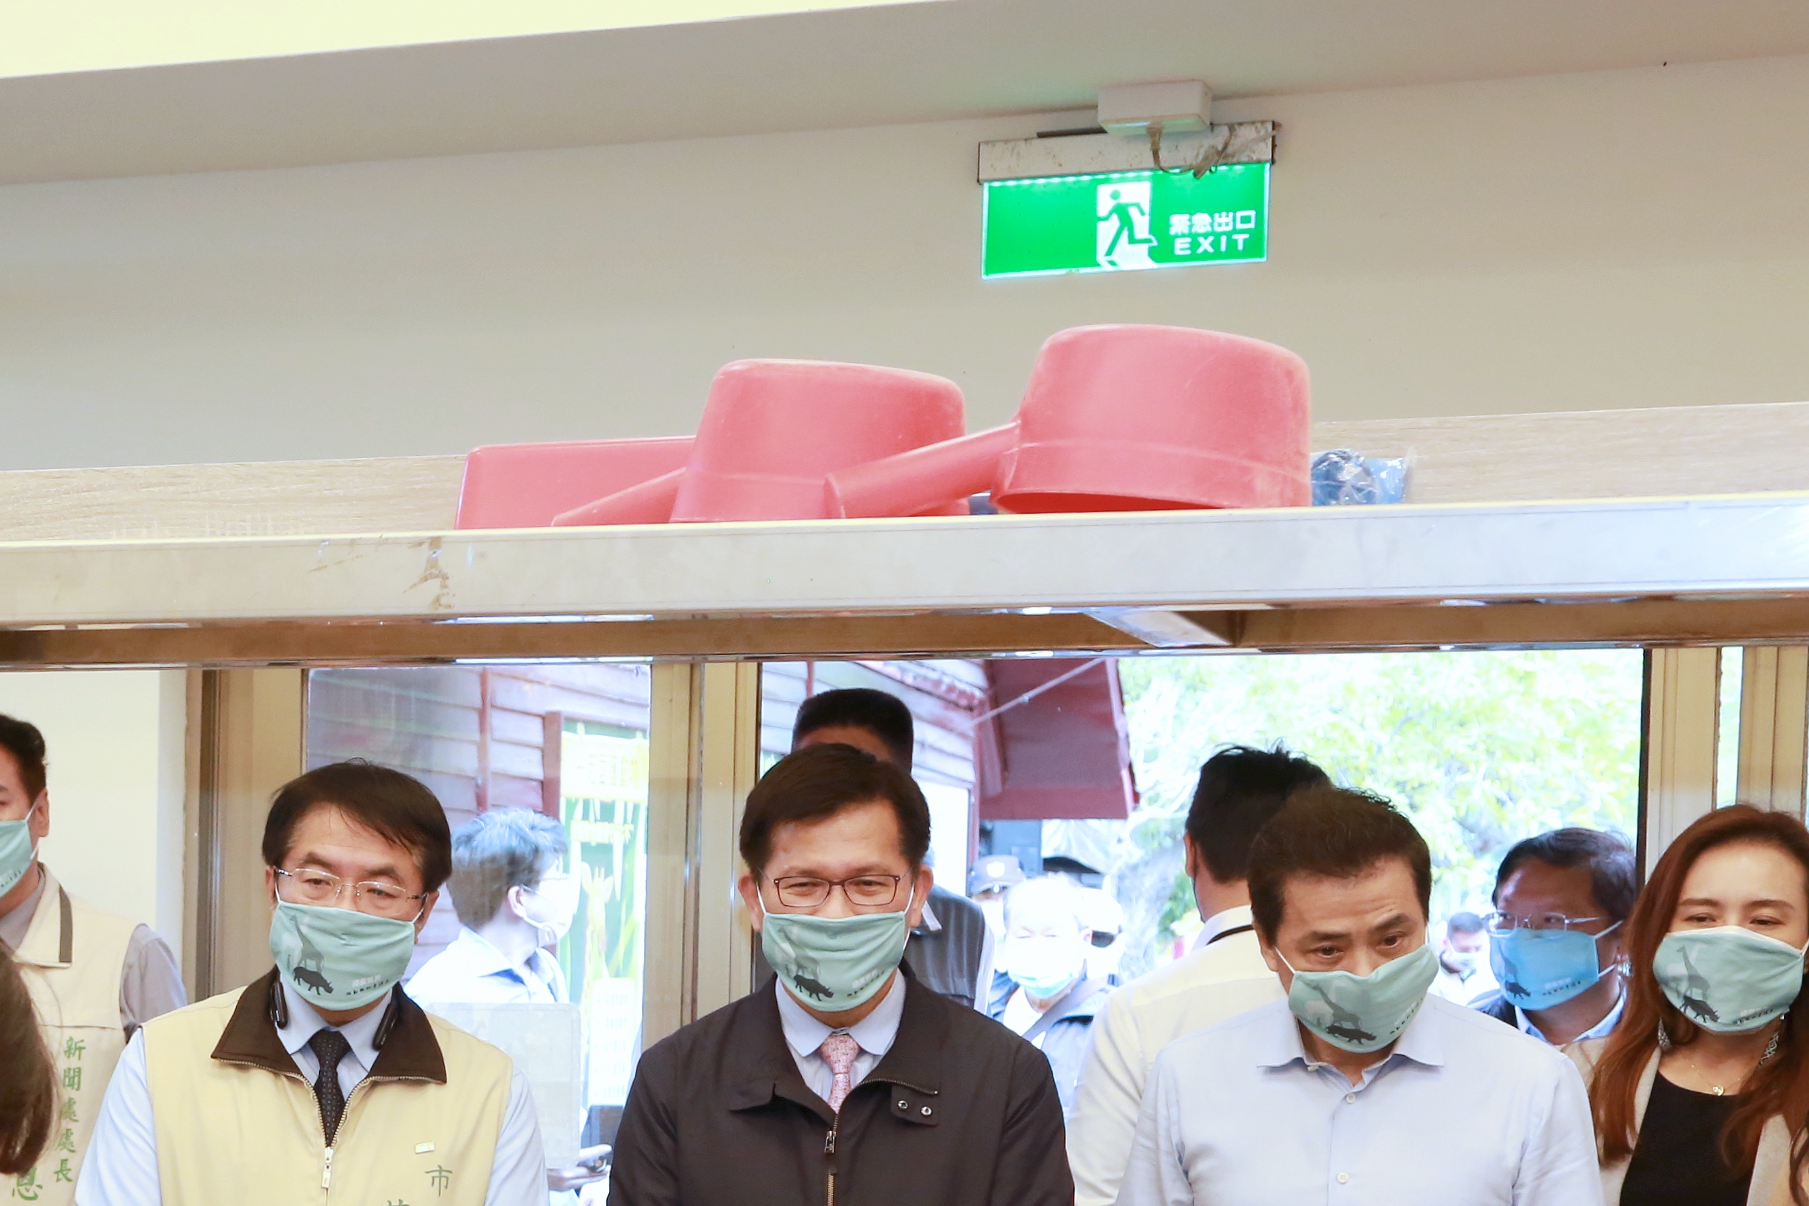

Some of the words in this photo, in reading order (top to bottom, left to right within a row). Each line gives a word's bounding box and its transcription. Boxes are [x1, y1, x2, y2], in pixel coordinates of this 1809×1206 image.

[1169, 210, 1256, 236] 緊急出口
[1174, 233, 1251, 256] EXIT
